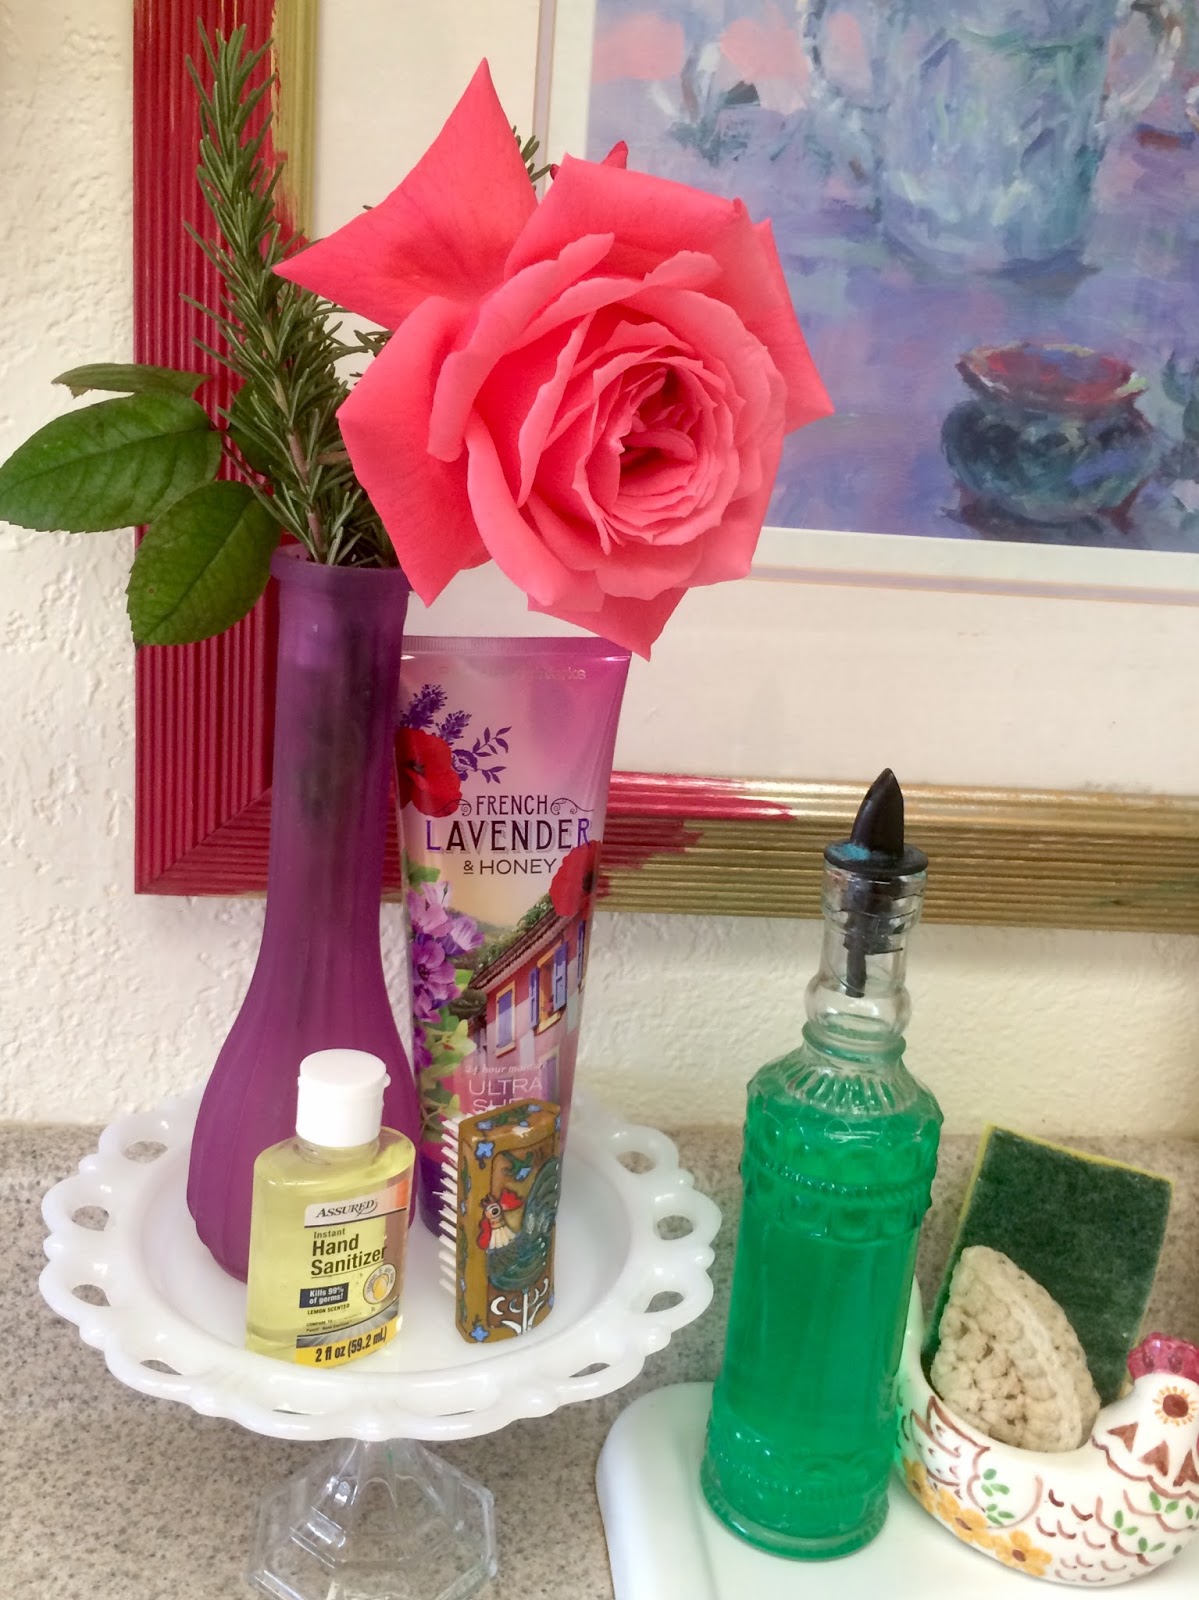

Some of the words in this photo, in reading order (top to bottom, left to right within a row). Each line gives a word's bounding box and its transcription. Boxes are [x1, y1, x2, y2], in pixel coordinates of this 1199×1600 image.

[476, 795, 548, 816] FRENCH
[426, 818, 592, 852] LAVENDER
[463, 860, 474, 874] &
[480, 858, 557, 875] HONEY
[482, 1063, 506, 1074] hour
[468, 1076, 543, 1095] ULTRA
[315, 1199, 378, 1218] ASSURED
[313, 1228, 346, 1239] Instant
[312, 1233, 360, 1257] Hand
[310, 1246, 387, 1276] Sanitizer
[309, 1289, 327, 1298] Kills
[328, 1286, 345, 1295] 99%
[309, 1297, 318, 1305] of
[319, 1293, 344, 1305] germs!
[327, 1303, 350, 1312] SCENTED
[315, 1347, 323, 1362] 2
[325, 1346, 333, 1361] fl
[334, 1345, 346, 1359] oz
[347, 1333, 372, 1358] (59.2
